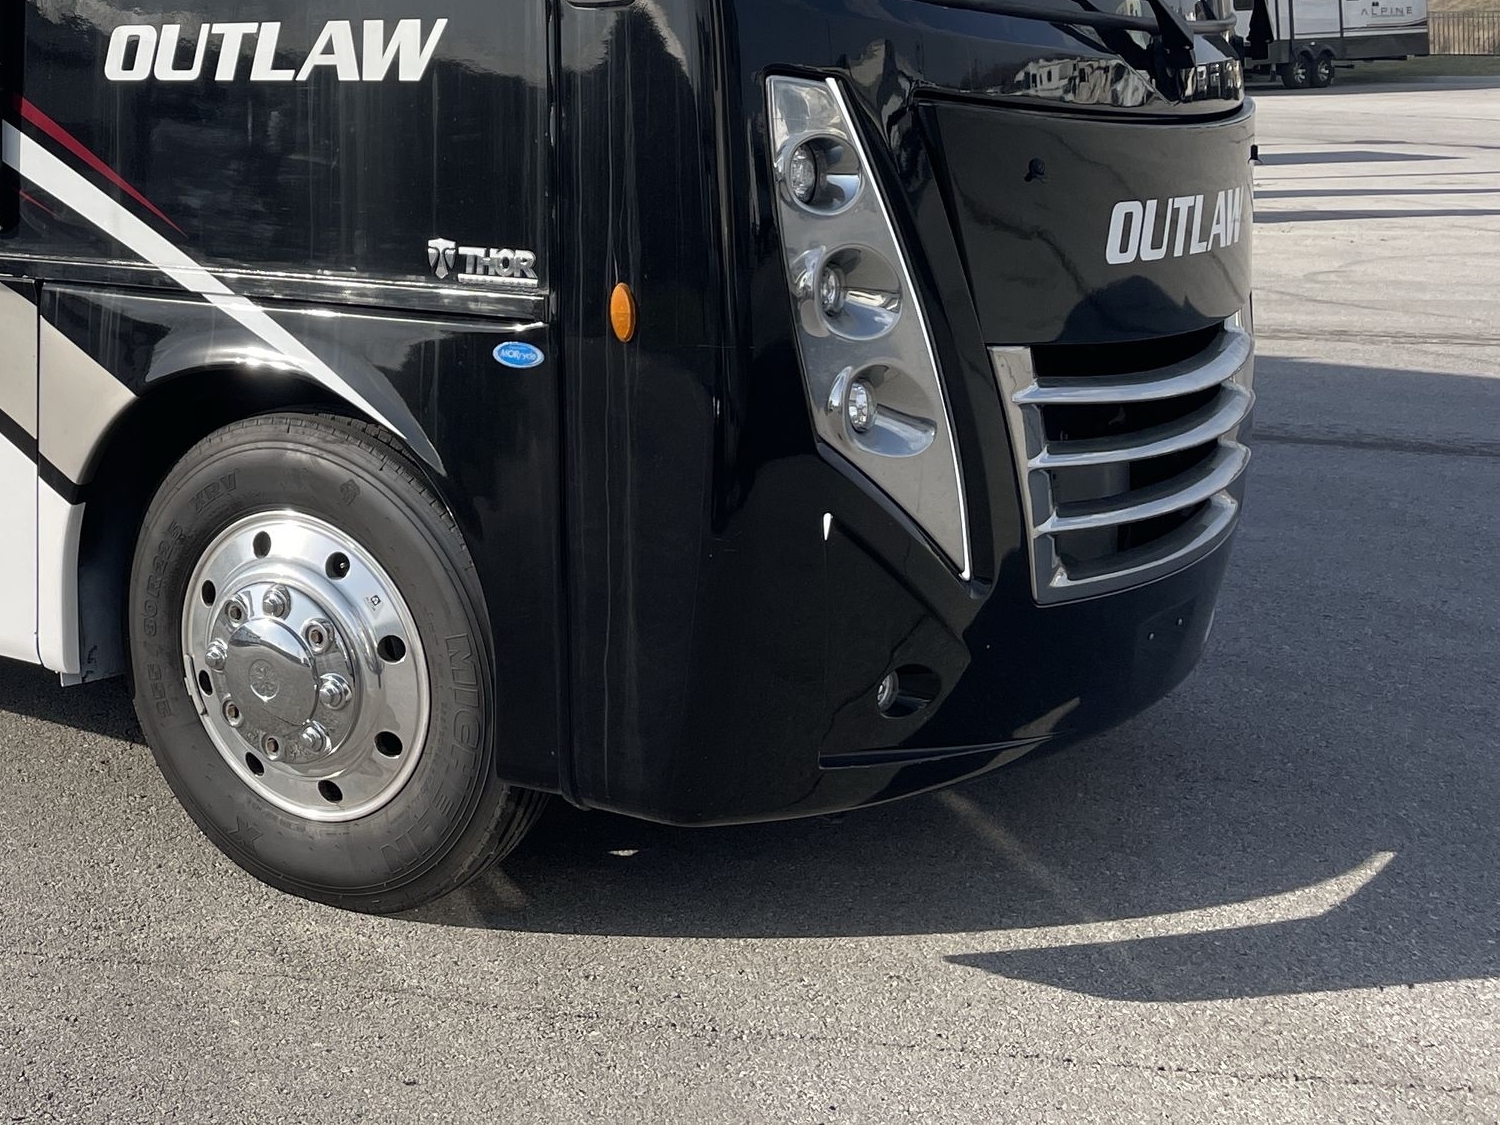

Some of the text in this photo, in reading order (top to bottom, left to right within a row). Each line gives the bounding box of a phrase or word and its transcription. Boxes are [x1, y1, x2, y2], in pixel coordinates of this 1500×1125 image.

[1361, 6, 1412, 16] ALPINE
[104, 18, 448, 81] OUTLAW
[1105, 186, 1244, 264] OUTLAW
[458, 246, 538, 278] THOR
